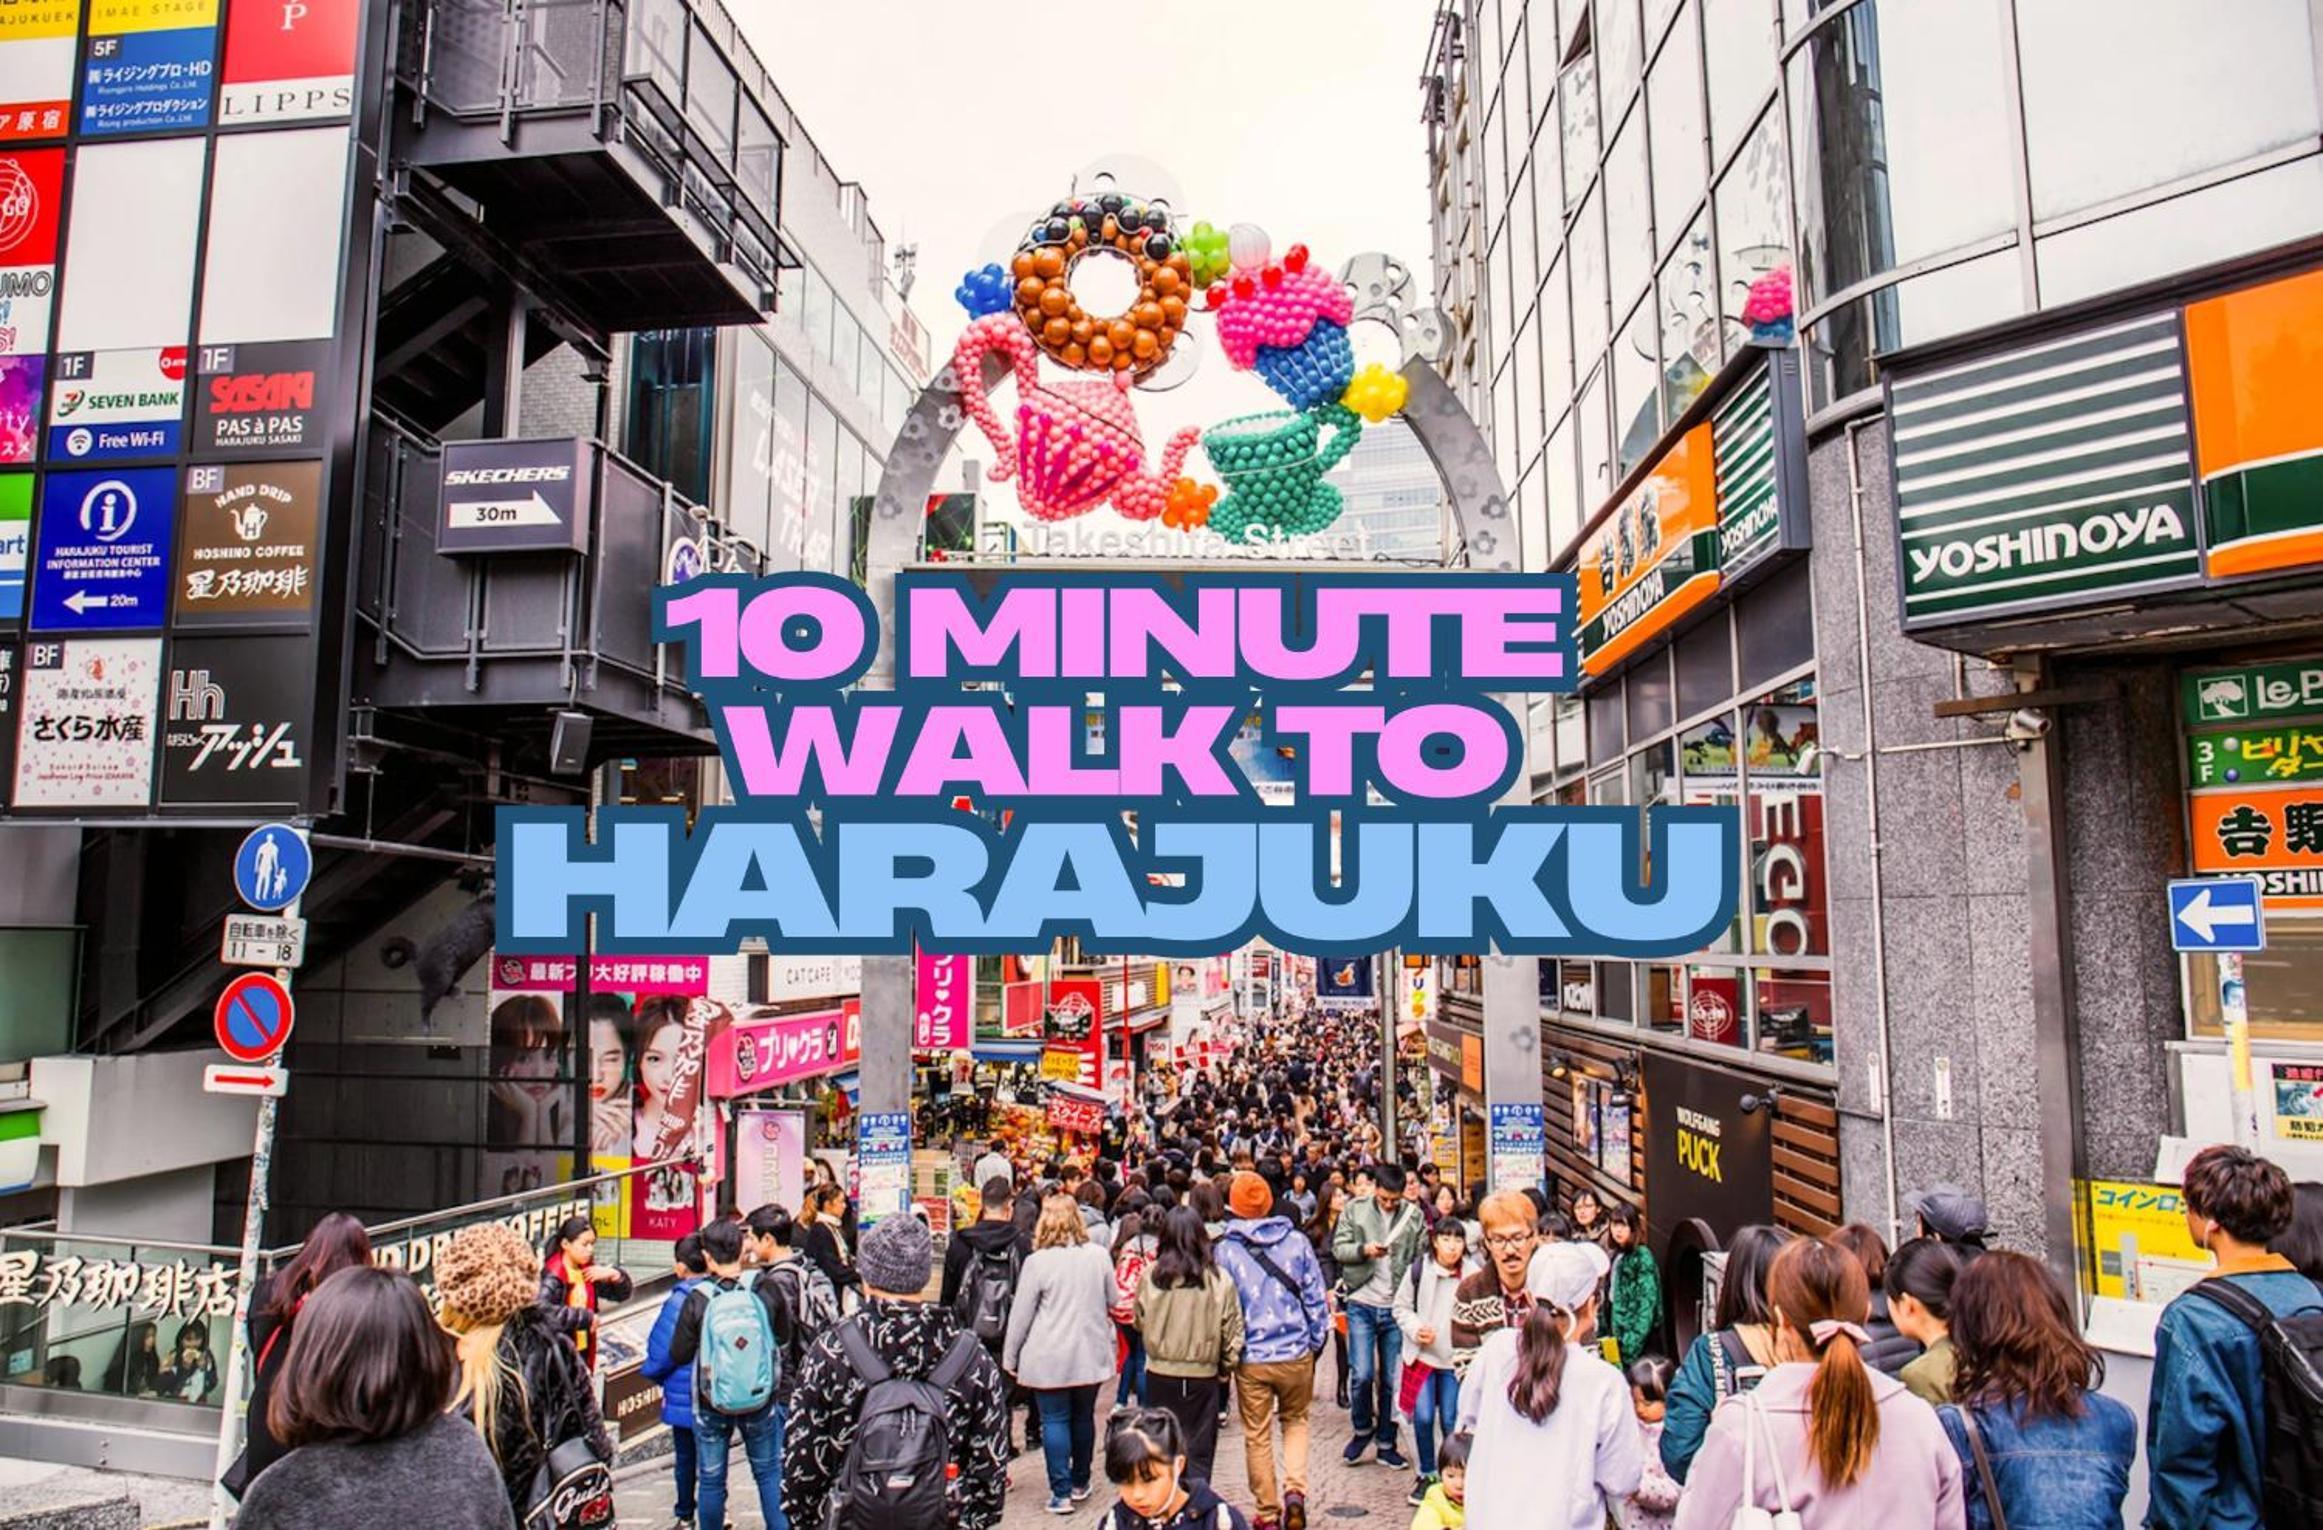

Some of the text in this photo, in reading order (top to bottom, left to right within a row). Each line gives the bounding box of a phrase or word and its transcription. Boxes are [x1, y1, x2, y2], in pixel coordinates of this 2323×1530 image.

[93, 40, 118, 57] 5F
[224, 87, 351, 116] LIPPS
[63, 356, 85, 377] 1F
[203, 347, 230, 371] 1F
[88, 394, 135, 410] SEVEN
[138, 391, 179, 407] BANK
[215, 417, 252, 437] PAS
[268, 415, 304, 434] PAS
[98, 431, 165, 449] Free Wi-Fi
[191, 468, 219, 490] BF
[445, 465, 570, 486] SKECHERS
[259, 484, 293, 504] DRIP
[475, 506, 518, 522] 30m
[1721, 493, 1779, 557] YOSHINOYA
[109, 543, 153, 556] TOURIST
[1023, 521, 1371, 559] Takeshita Street
[1909, 504, 2187, 584] YOSHINOYA
[46, 556, 161, 570] INFORMATION CENTER
[193, 545, 305, 560] HOSHINO COFFEE
[186, 563, 309, 600] 星乃珈琲
[109, 593, 138, 607] 20m
[1602, 569, 1665, 642] YOSHINOYA
[33, 644, 59, 667] BF
[33, 714, 146, 742] さくら水産
[276, 944, 293, 961] 18
[1676, 1106, 1721, 1137] WOLFGANG
[1677, 1128, 1722, 1183] PUCK
[648, 1216, 678, 1229] KATY
[0, 1249, 241, 1326] 星乃珈琲店
